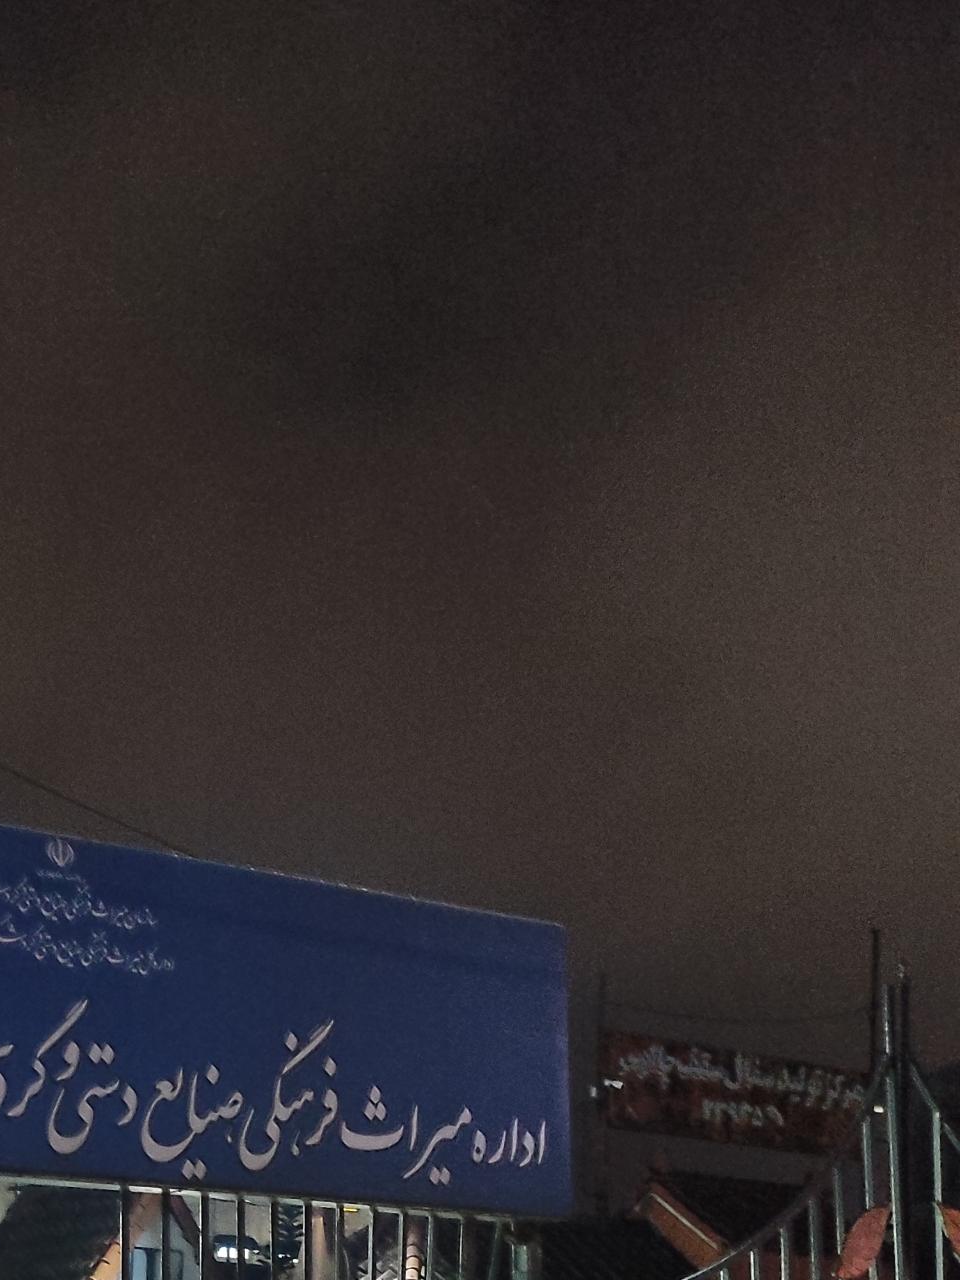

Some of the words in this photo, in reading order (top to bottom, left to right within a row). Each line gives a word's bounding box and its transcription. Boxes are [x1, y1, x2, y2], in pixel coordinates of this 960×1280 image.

[48, 1042, 139, 1155] دستی
[54, 1040, 80, 1083] و
[238, 1019, 339, 1172] فرهنگی
[141, 1063, 243, 1180] صنایع
[339, 1084, 472, 1186] میراث
[471, 1117, 547, 1168] اداره
